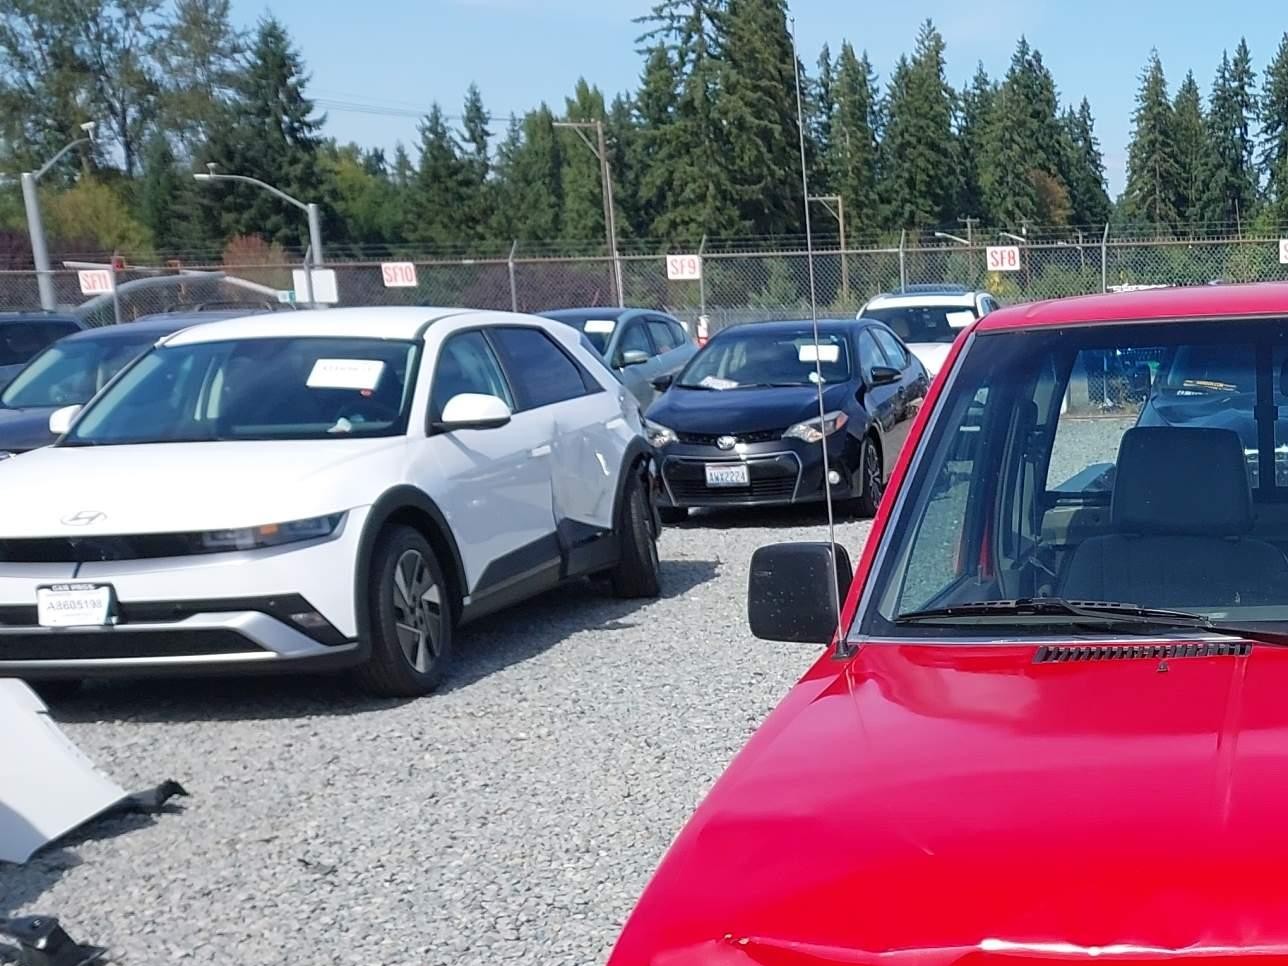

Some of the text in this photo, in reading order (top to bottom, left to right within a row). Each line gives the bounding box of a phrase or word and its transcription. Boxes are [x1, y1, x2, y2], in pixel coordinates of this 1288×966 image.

[670, 258, 696, 275] SF9
[990, 249, 1016, 267] SF8
[383, 264, 414, 283] SF10
